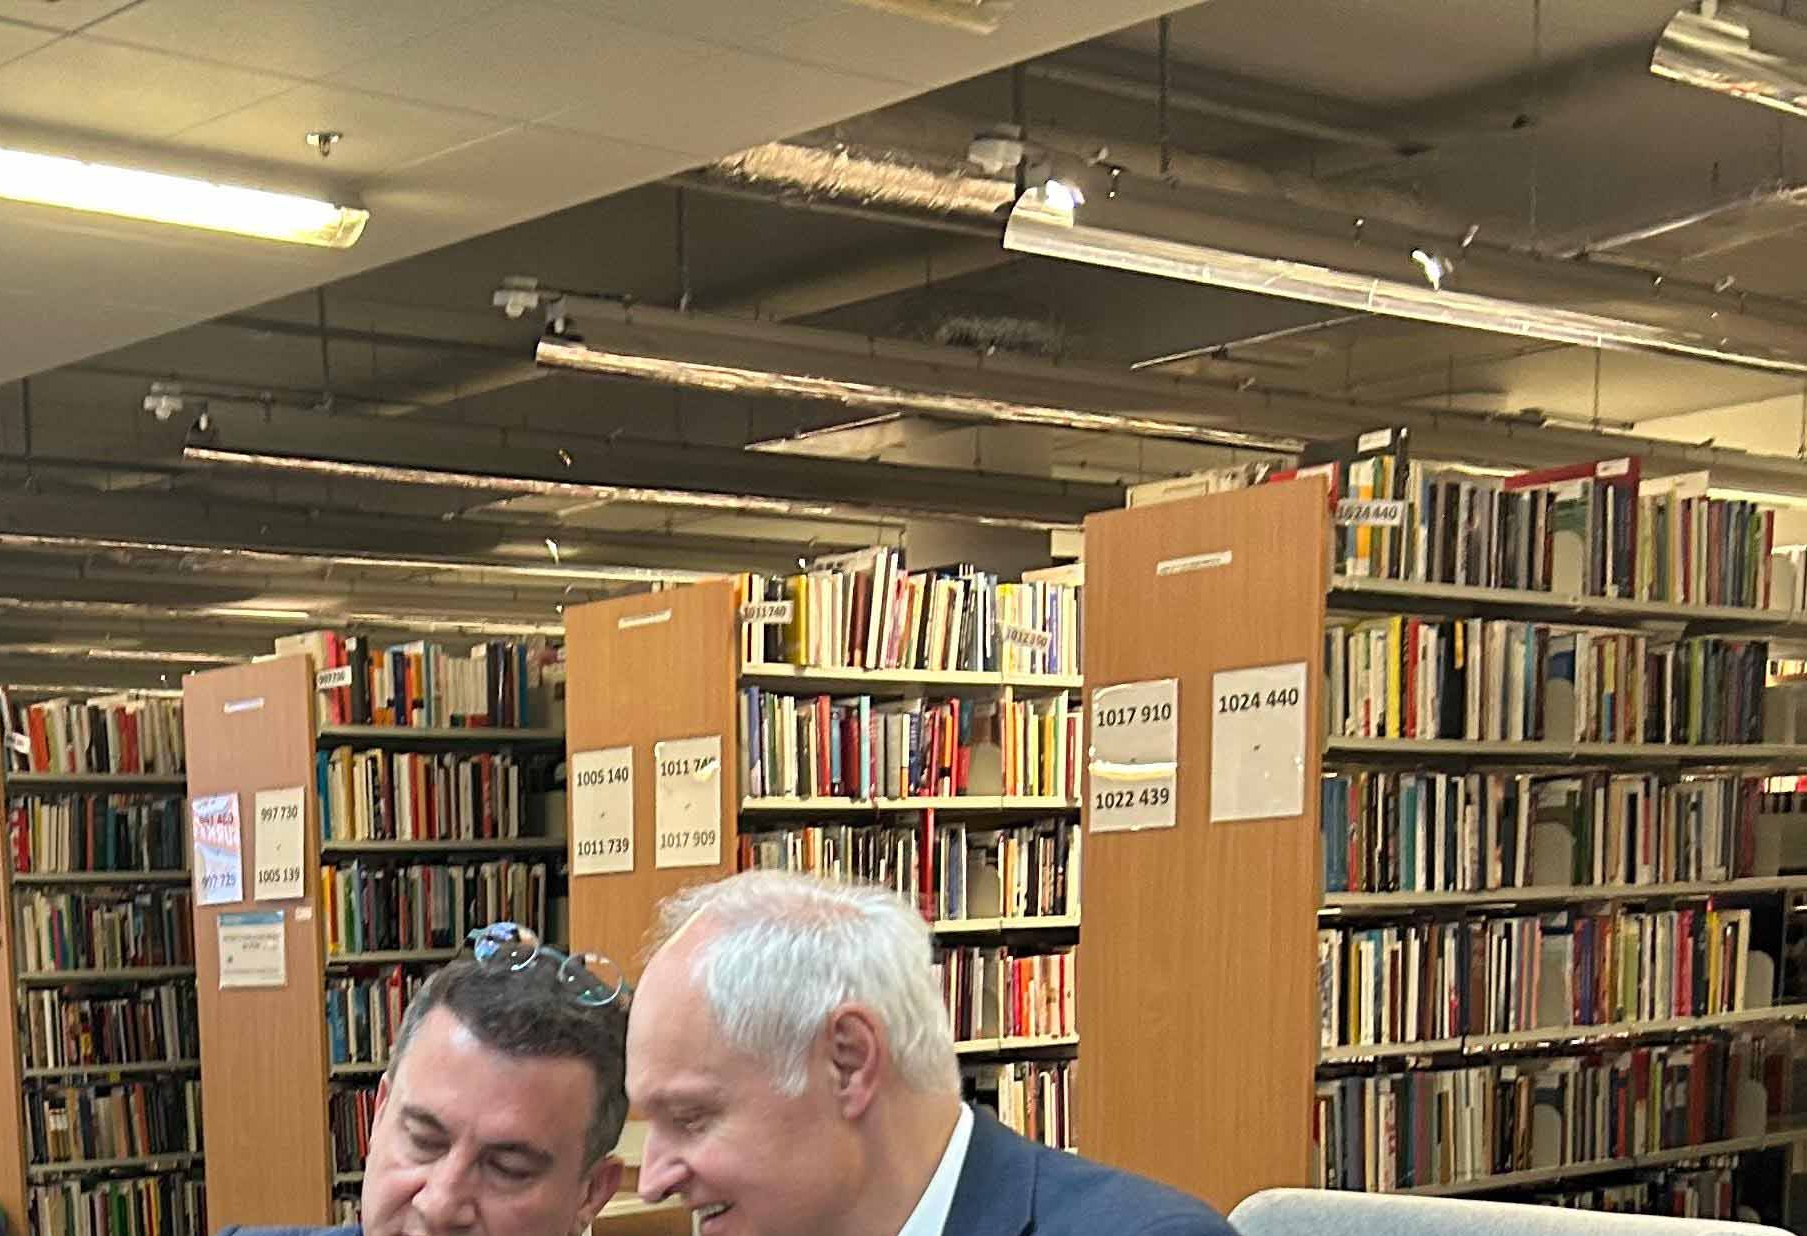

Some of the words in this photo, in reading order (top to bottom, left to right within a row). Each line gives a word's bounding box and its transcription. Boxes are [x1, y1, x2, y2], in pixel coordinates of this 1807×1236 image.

[1218, 692, 1260, 713] 1024
[1266, 687, 1300, 708] 440
[1097, 706, 1137, 727] 1017
[1142, 702, 1172, 723] 910
[577, 769, 605, 787] 1005
[608, 766, 629, 784] 140
[660, 759, 690, 777] 1011
[1095, 791, 1135, 810] 1022
[1139, 787, 1170, 807] 439
[260, 807, 279, 823] 997
[280, 805, 298, 821] 730
[577, 839, 605, 856] 1011
[608, 837, 630, 853] 739
[659, 831, 689, 849] 1017
[692, 829, 717, 846] 909
[258, 868, 280, 884] 1005
[283, 867, 301, 883] 139
